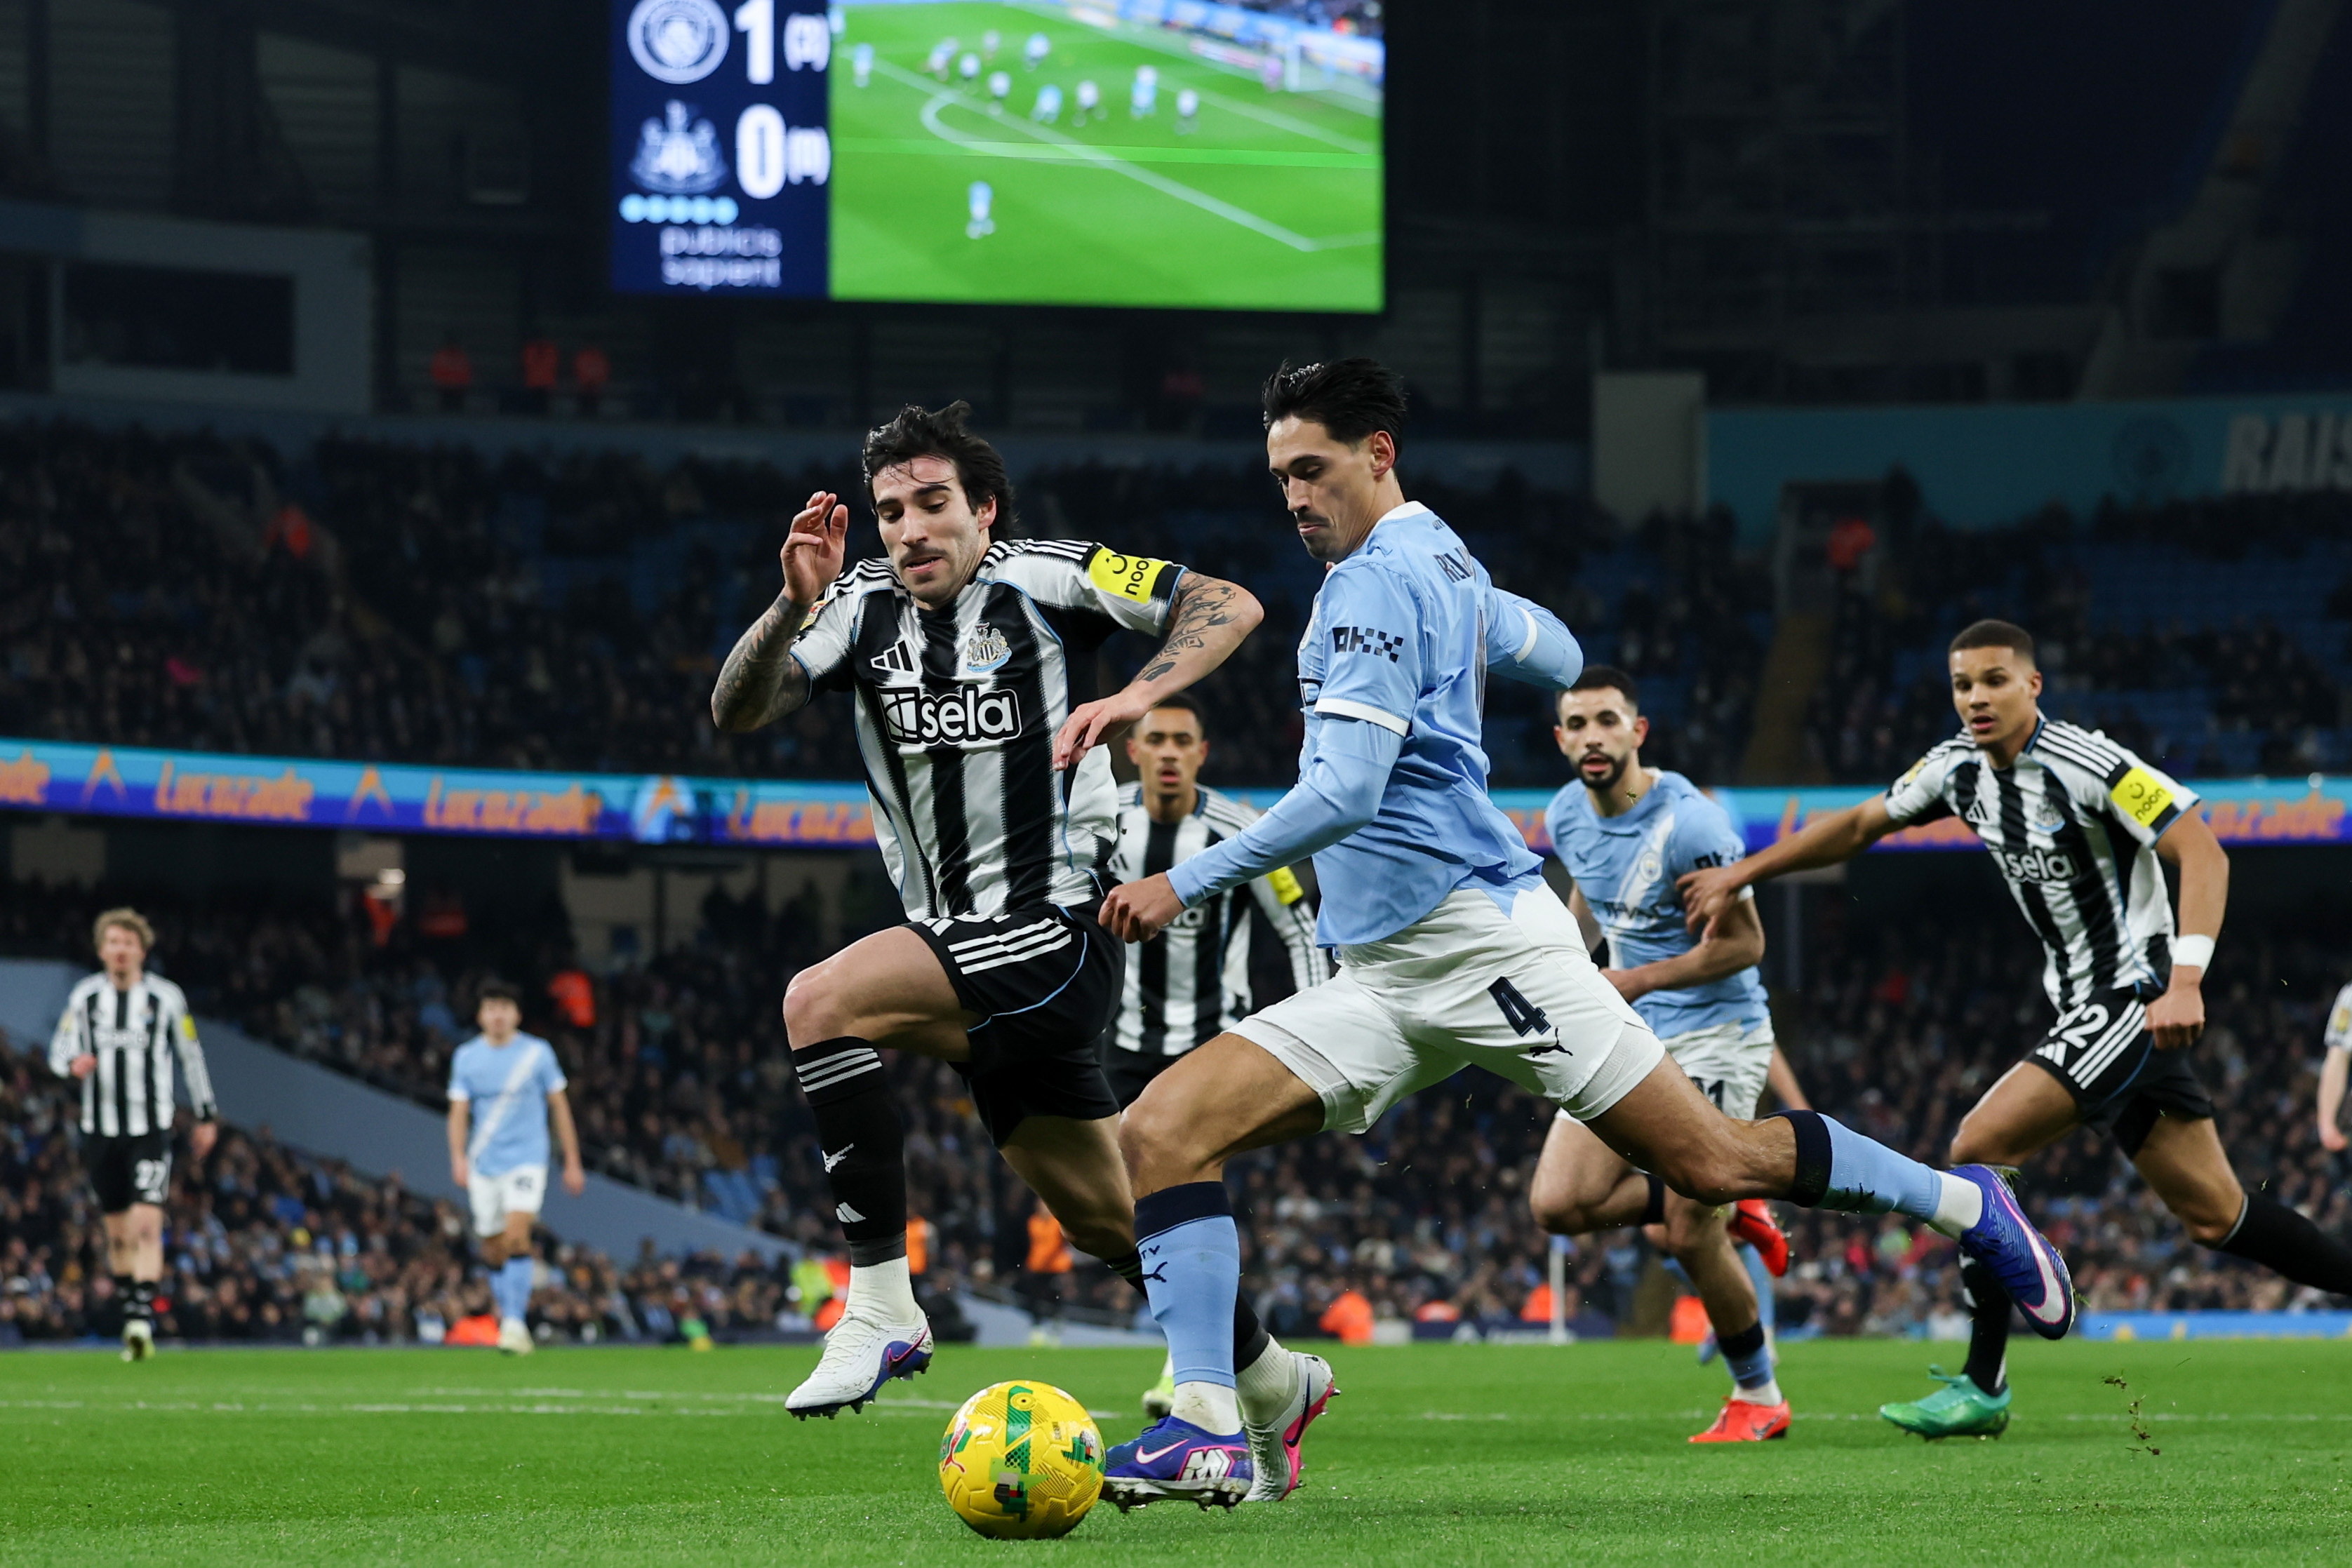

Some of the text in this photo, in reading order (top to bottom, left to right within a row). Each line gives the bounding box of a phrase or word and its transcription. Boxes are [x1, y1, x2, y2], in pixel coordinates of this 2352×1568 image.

[735, 0, 774, 84] 1
[736, 103, 786, 199] 0
[1124, 559, 1151, 596] noo
[1332, 626, 1403, 663] OKX
[921, 690, 1014, 737] sela
[2006, 848, 2074, 879] sela
[1488, 976, 1551, 1037] 4
